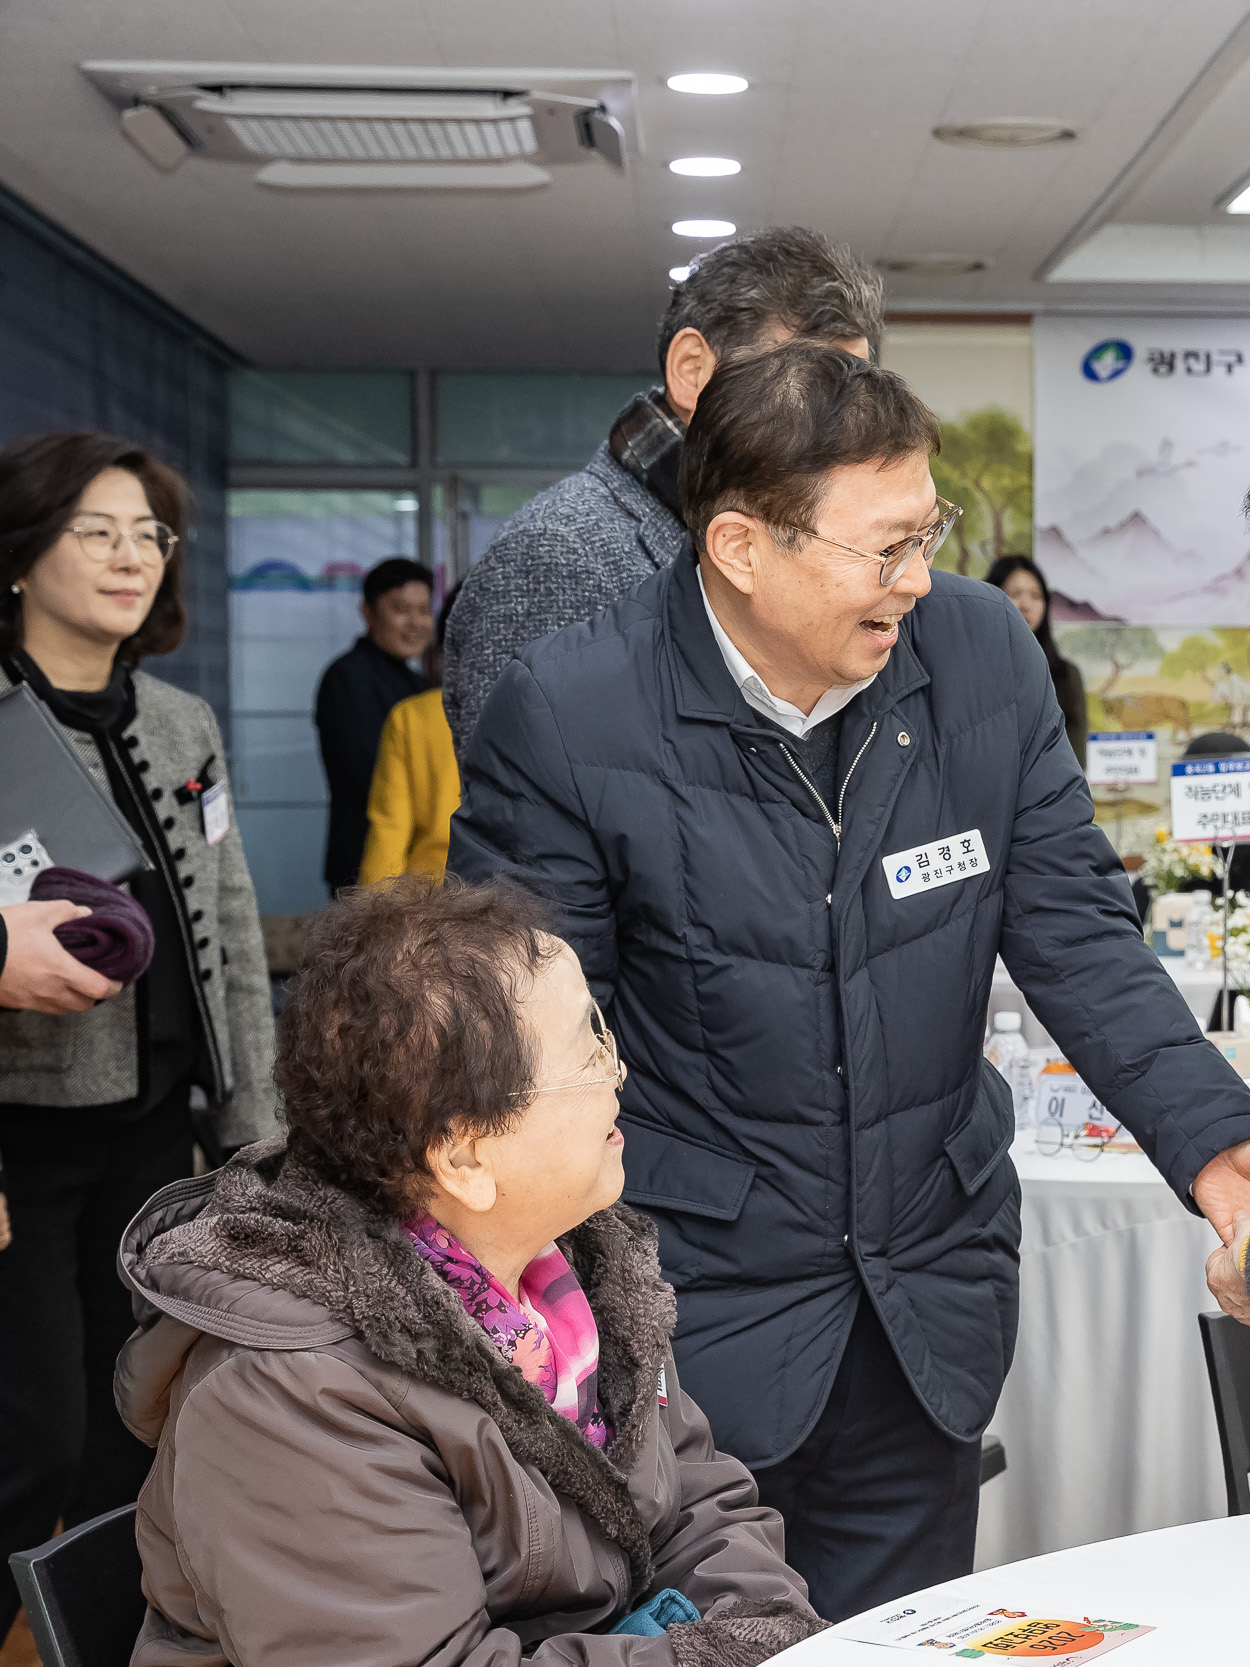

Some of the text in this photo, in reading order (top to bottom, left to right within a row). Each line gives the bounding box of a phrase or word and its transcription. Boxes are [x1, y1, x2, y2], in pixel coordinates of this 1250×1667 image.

[1146, 348, 1244, 378] 광진구
[921, 857, 978, 883] 광진구청장
[980, 1621, 1061, 1651] 업무보고회
[1028, 1630, 1085, 1651] 2026
